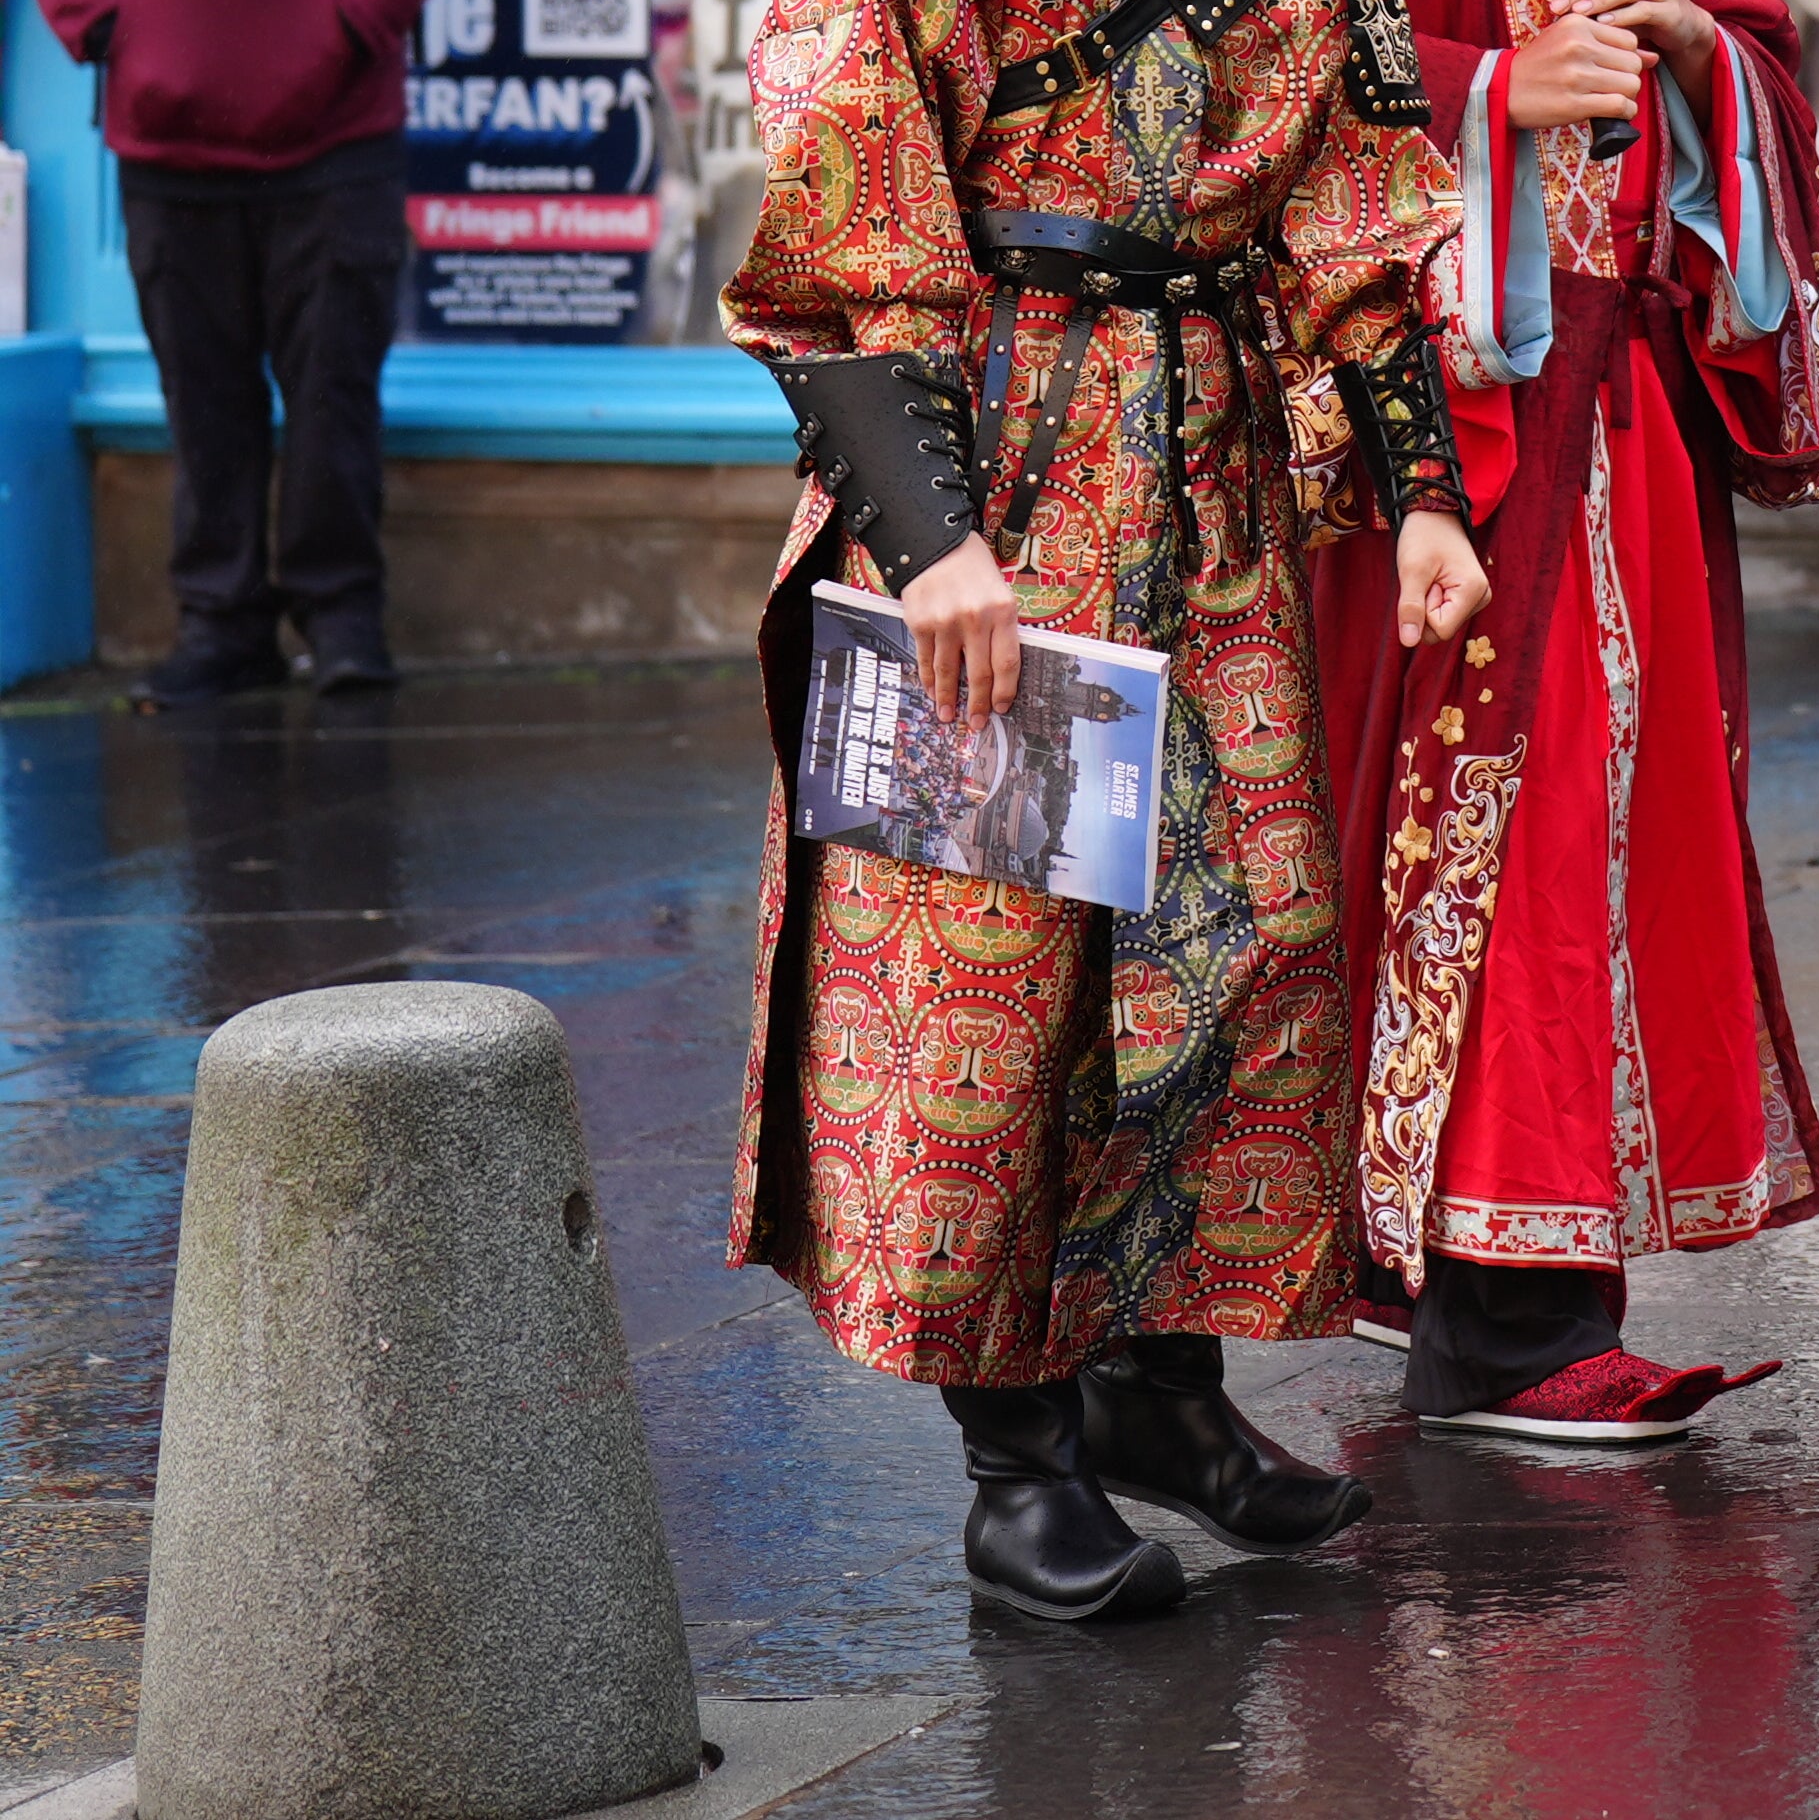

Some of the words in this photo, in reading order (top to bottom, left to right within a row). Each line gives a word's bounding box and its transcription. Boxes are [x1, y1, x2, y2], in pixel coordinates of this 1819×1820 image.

[405, 76, 614, 132] ERFAN?
[467, 163, 570, 190] Become
[423, 201, 534, 245] Fringe
[538, 200, 651, 238] Friend
[853, 645, 878, 710] AROUND
[877, 660, 902, 688] THE
[847, 710, 872, 741] THE
[871, 688, 901, 747] FRINGE
[840, 740, 870, 809] QUARTER
[869, 744, 893, 767] IS
[865, 769, 892, 808] JUST
[1110, 760, 1126, 817] QUARTER
[1123, 778, 1138, 820] JAMES
